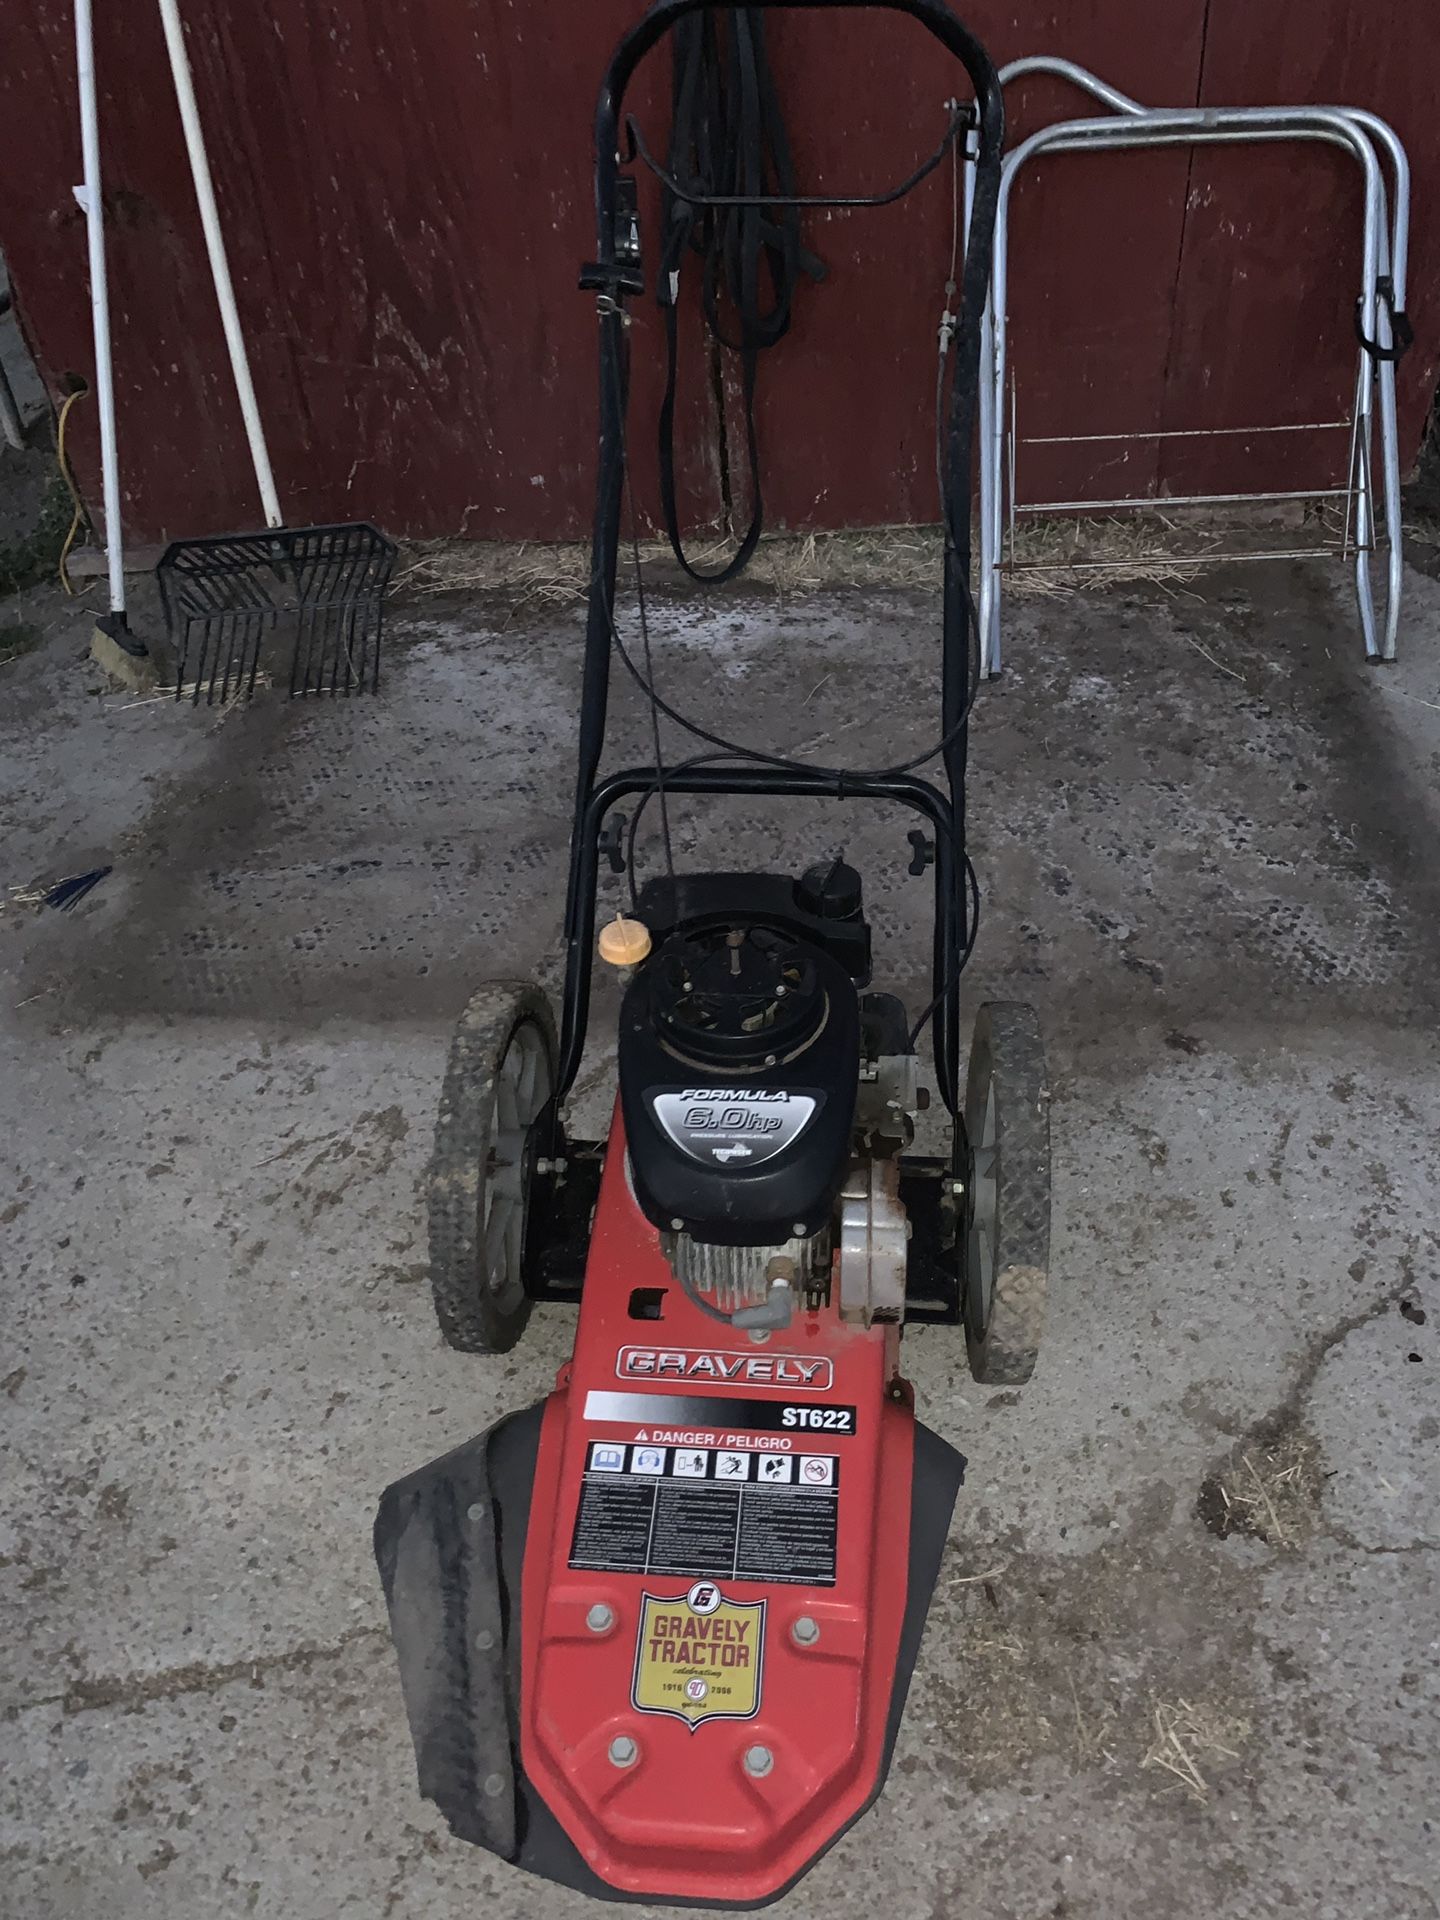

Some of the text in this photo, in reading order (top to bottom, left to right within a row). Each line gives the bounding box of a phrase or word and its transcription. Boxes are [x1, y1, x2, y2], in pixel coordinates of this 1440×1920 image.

[679, 1089, 790, 1102] FORMULA
[683, 1107, 783, 1132] 6.0hp
[626, 1351, 824, 1382] GRAVELY
[782, 1407, 851, 1429] ST622
[652, 1430, 792, 1449] DANGER / PELIGRO
[654, 1615, 751, 1642] GRAVELY
[649, 1639, 750, 1667] TRACTOR
[673, 1667, 722, 1678] celebrating
